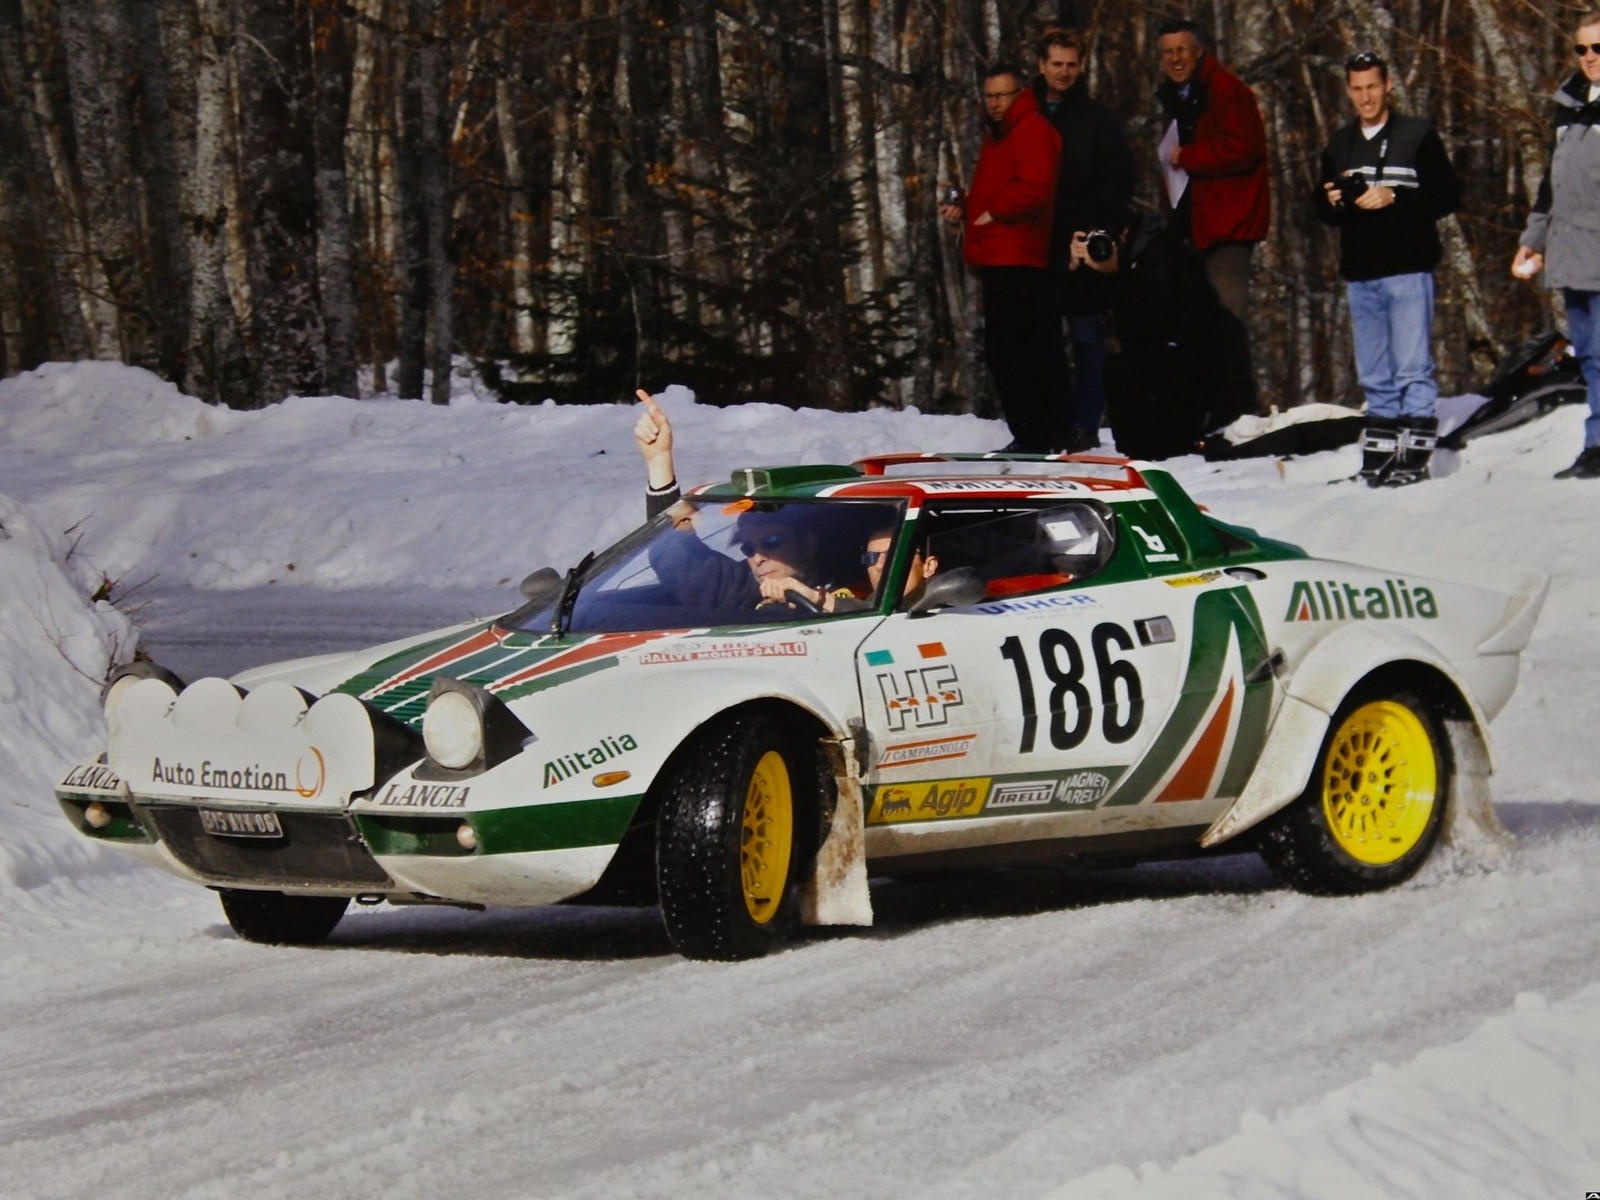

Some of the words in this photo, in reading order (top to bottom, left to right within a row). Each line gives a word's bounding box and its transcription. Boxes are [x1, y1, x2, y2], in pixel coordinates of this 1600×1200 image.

[977, 594, 1097, 615] UNHCR
[1284, 579, 1439, 622] Alitalia
[876, 664, 964, 732] HF
[1000, 622, 1144, 754] 186
[543, 734, 638, 789] Alitalia
[893, 741, 969, 761] CAMPAGNOLO
[152, 756, 195, 785] Auto
[200, 760, 288, 791] Emotion
[380, 783, 471, 808] LANCIA
[919, 782, 979, 816] Agip
[992, 783, 1051, 804] PIRELLI
